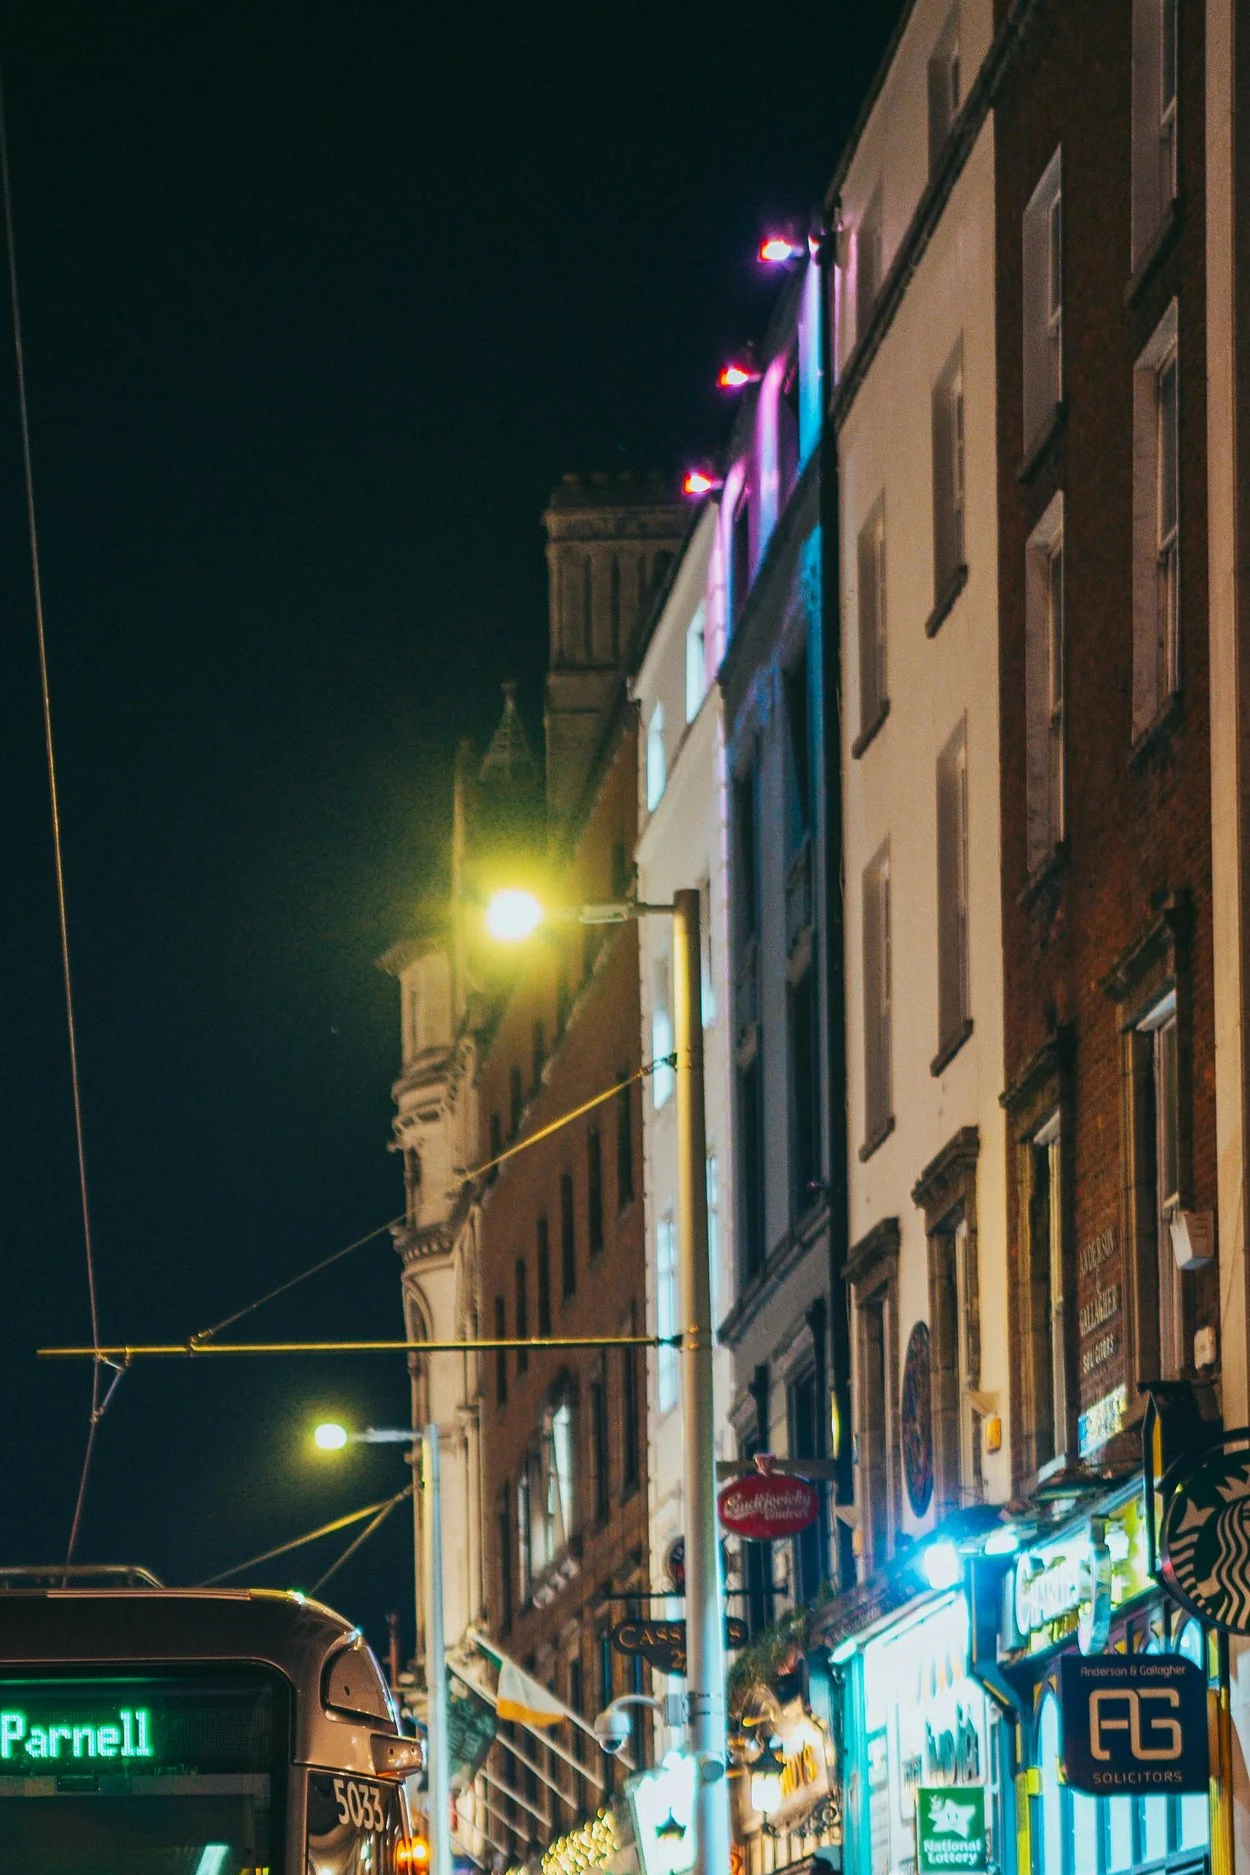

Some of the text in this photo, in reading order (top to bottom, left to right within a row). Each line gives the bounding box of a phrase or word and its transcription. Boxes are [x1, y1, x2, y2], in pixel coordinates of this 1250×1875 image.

[1080, 1664, 1186, 1678] Anderson & Gallagher
[1088, 1687, 1183, 1761] AG
[0, 1710, 152, 1758] Parnell
[1092, 1771, 1183, 1785] SOLICITORS
[333, 1778, 385, 1833] 5033
[924, 1838, 982, 1853] National
[927, 1851, 979, 1866] Lottery
